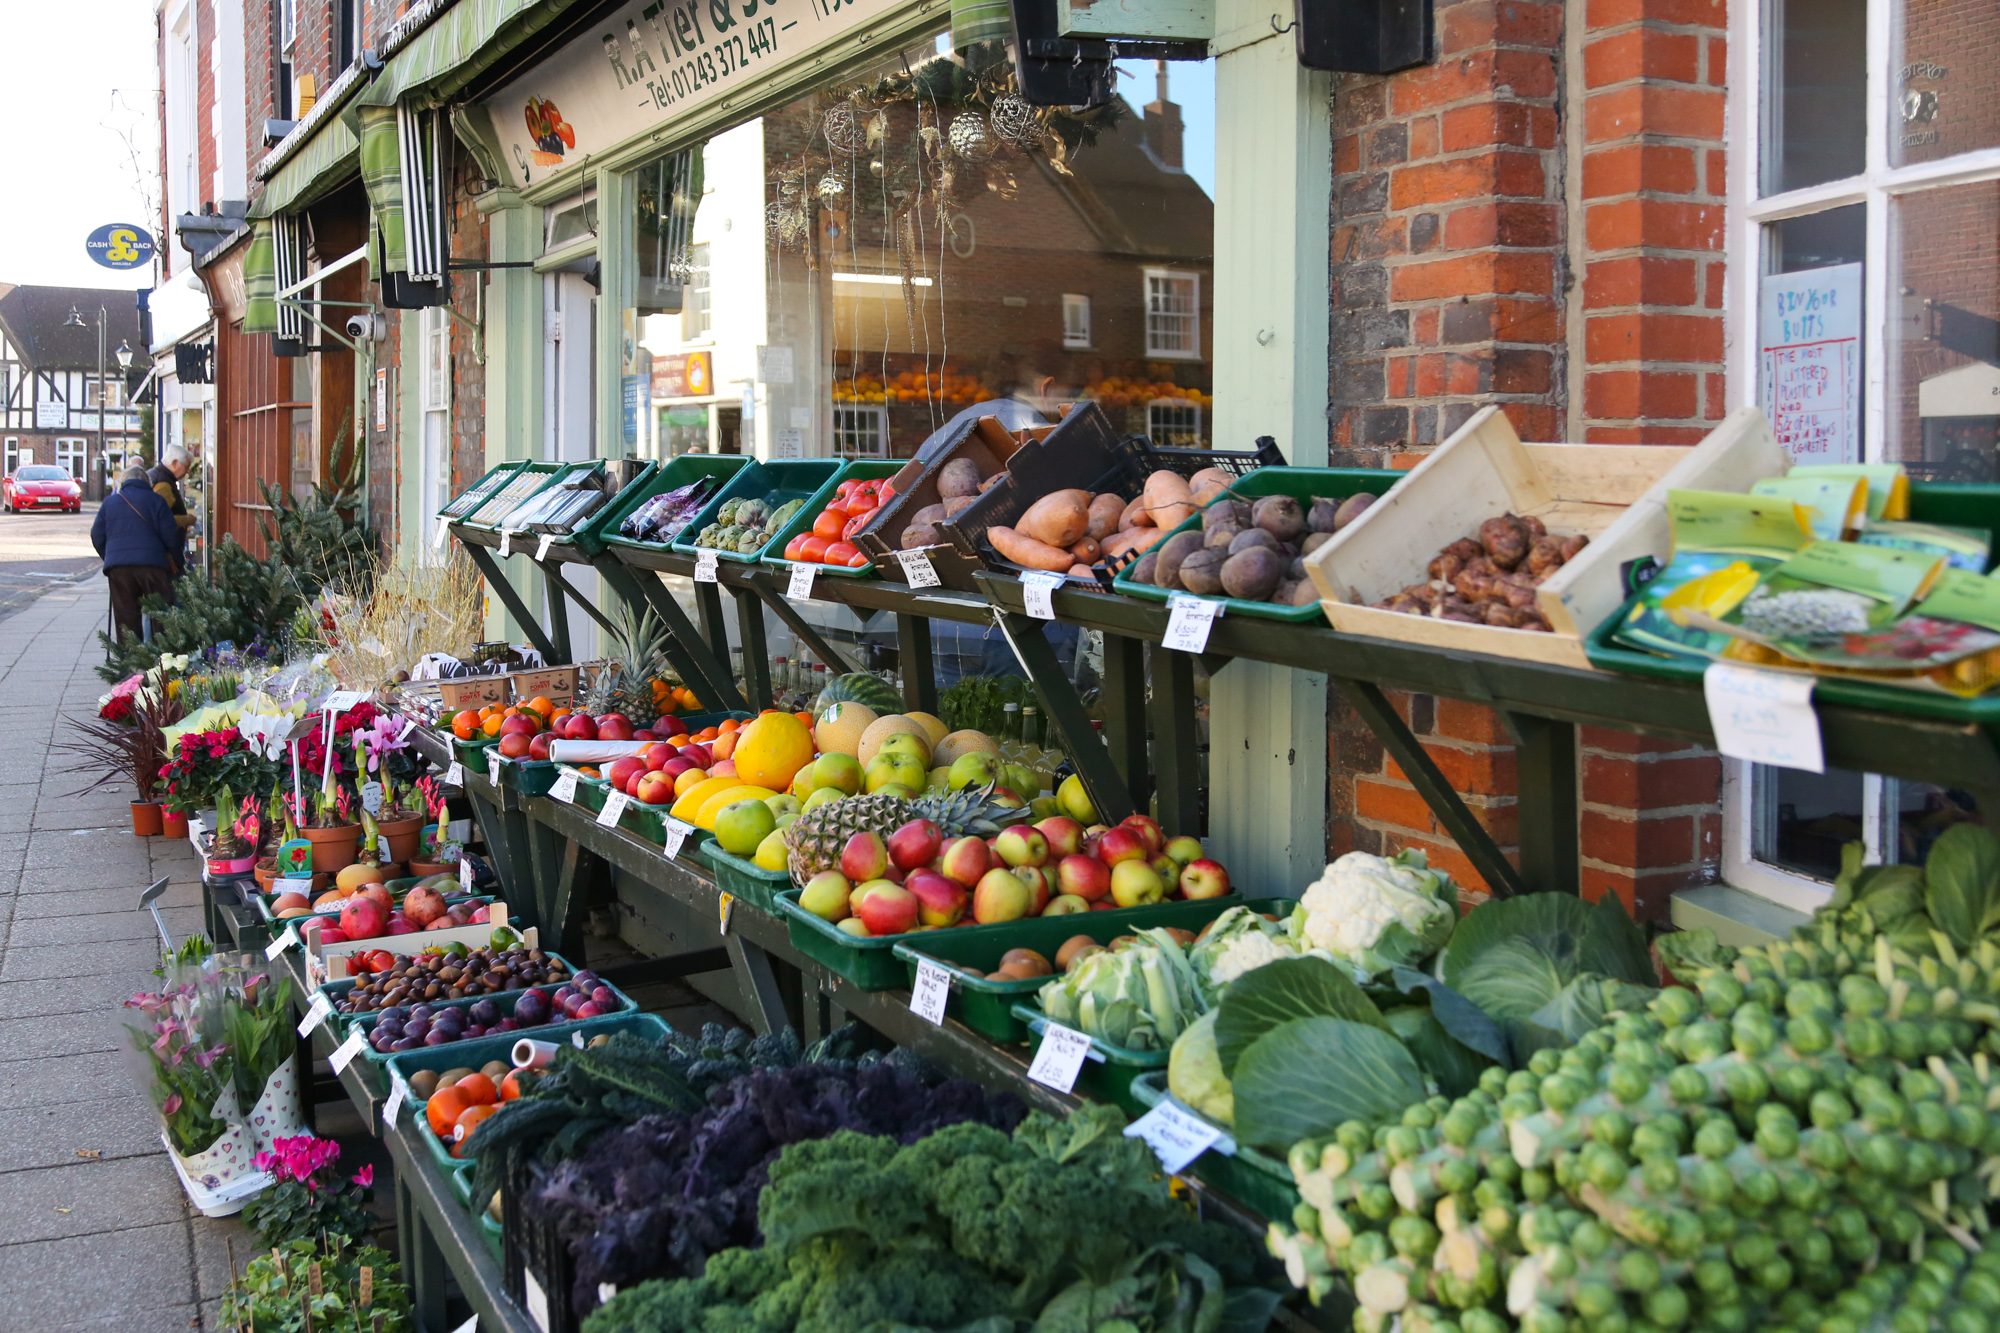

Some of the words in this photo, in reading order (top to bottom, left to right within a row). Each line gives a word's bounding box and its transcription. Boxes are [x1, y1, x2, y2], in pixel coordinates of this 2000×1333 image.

[646, 74, 676, 111] Tel:
[672, 52, 718, 99] 01243
[714, 35, 749, 77] 372
[748, 16, 777, 59] 447
[87, 241, 108, 249] CASH
[1783, 314, 1824, 342] BUTTS
